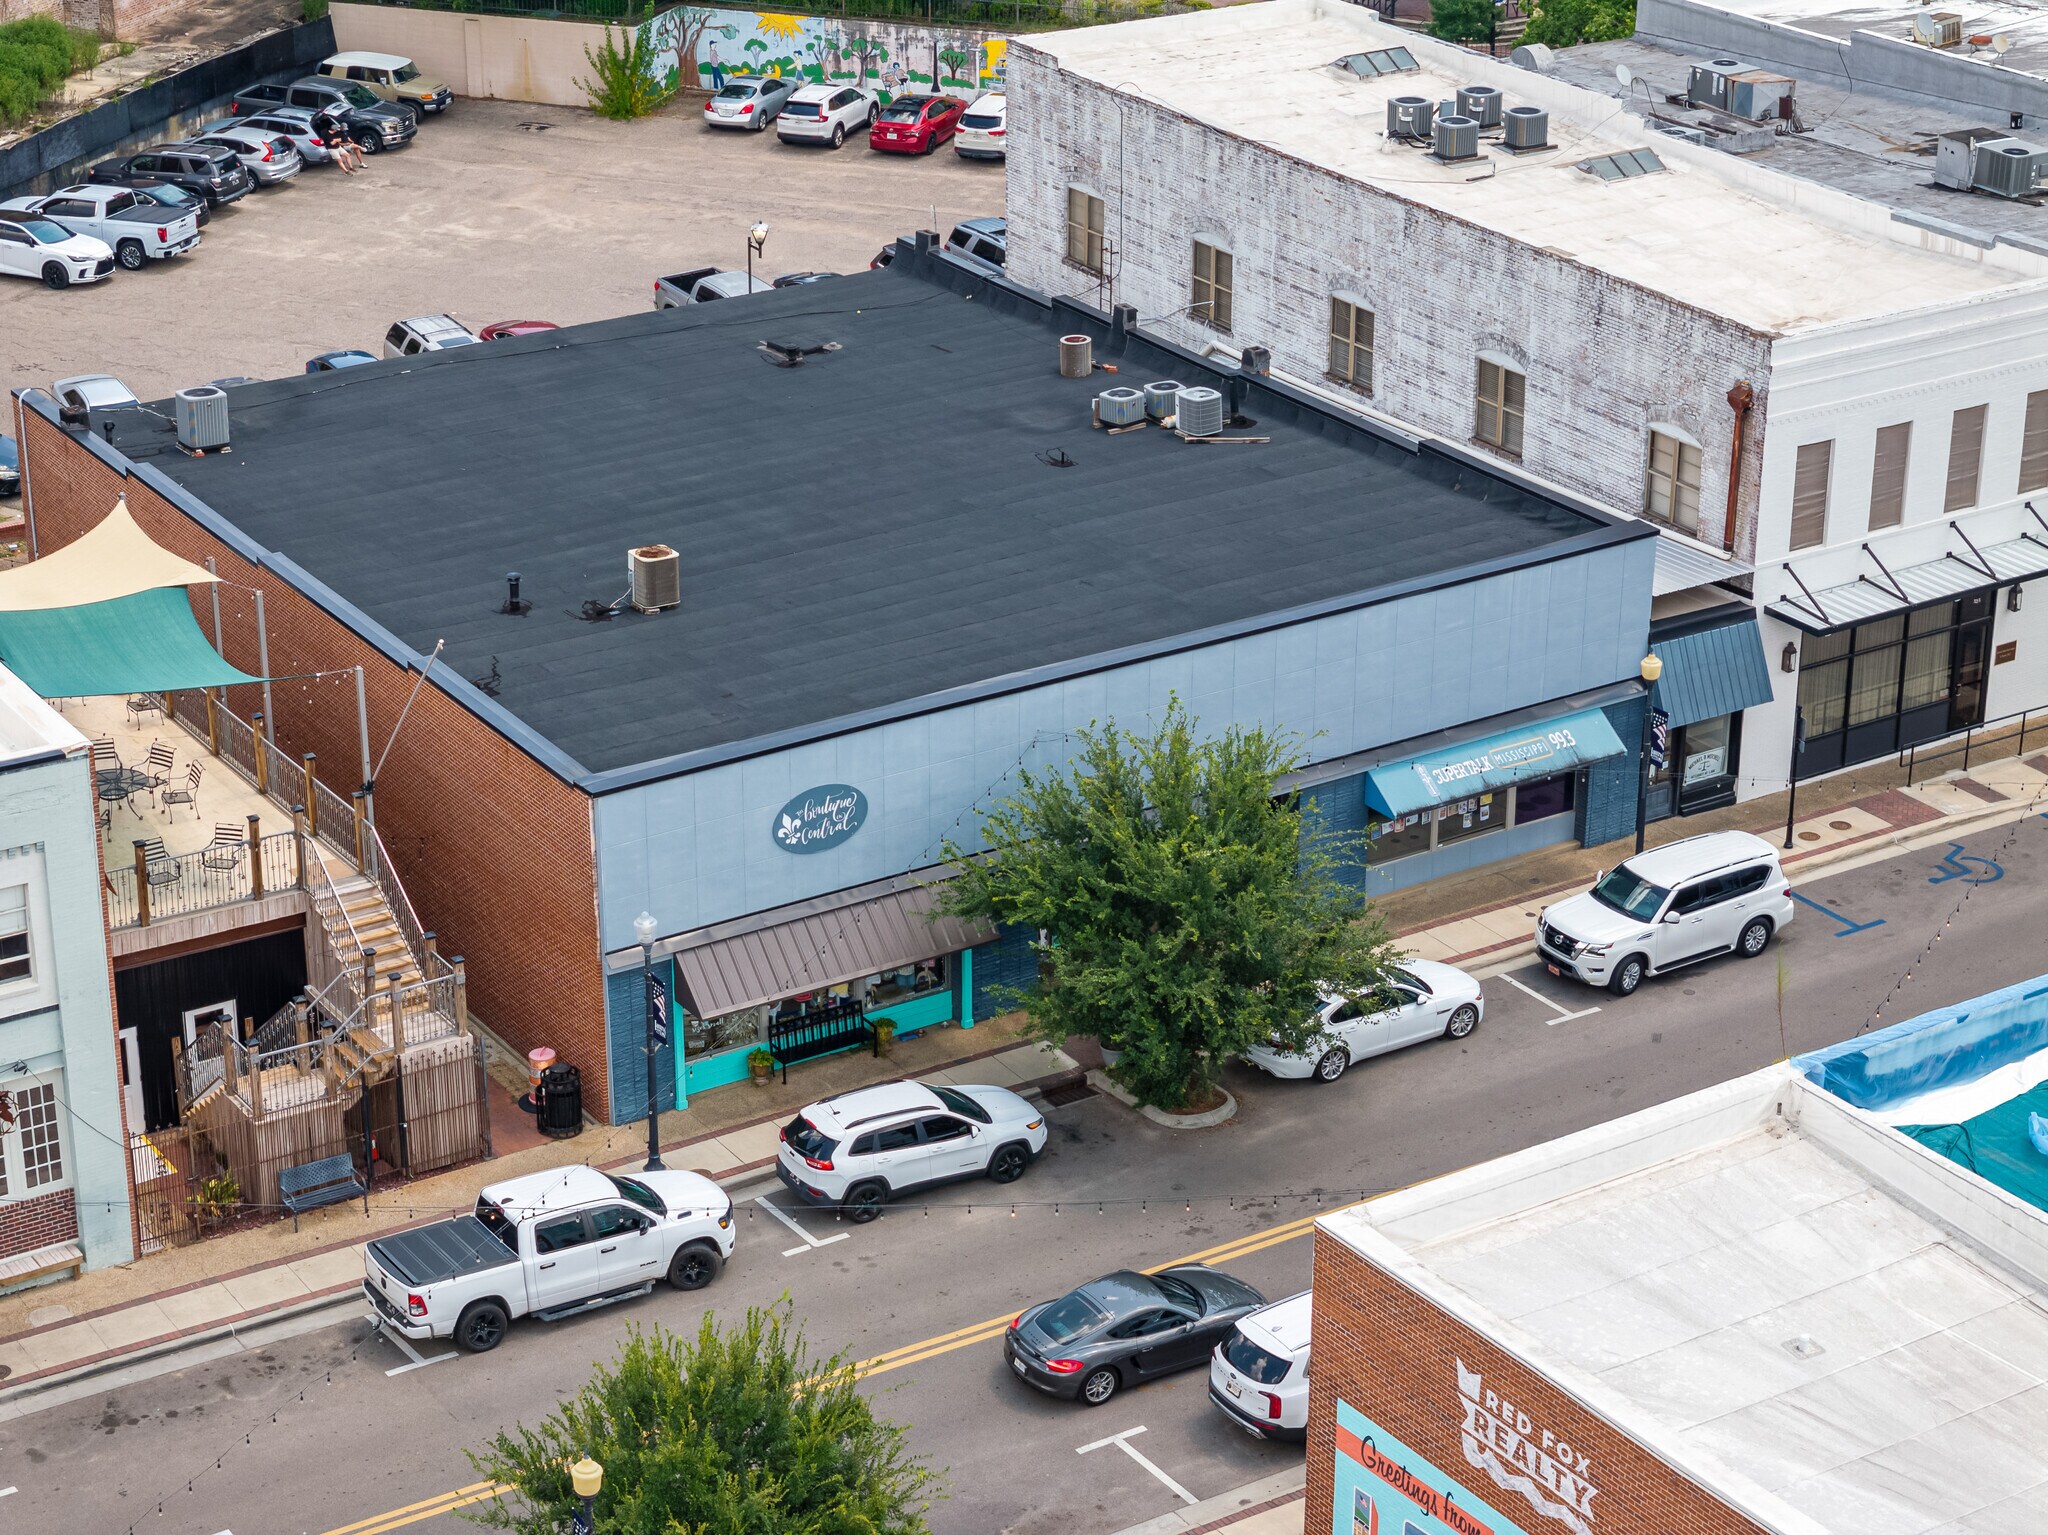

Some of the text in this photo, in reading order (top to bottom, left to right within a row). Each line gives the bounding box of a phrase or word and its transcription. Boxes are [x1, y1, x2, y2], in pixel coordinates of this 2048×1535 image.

[1494, 741, 1550, 765] MISSISSIPPI
[1548, 729, 1577, 750] 99.3
[1473, 1408, 1590, 1507] REALTY
[1485, 1388, 1591, 1480] RED FOX
[1361, 1435, 1482, 1535] Greetings from
